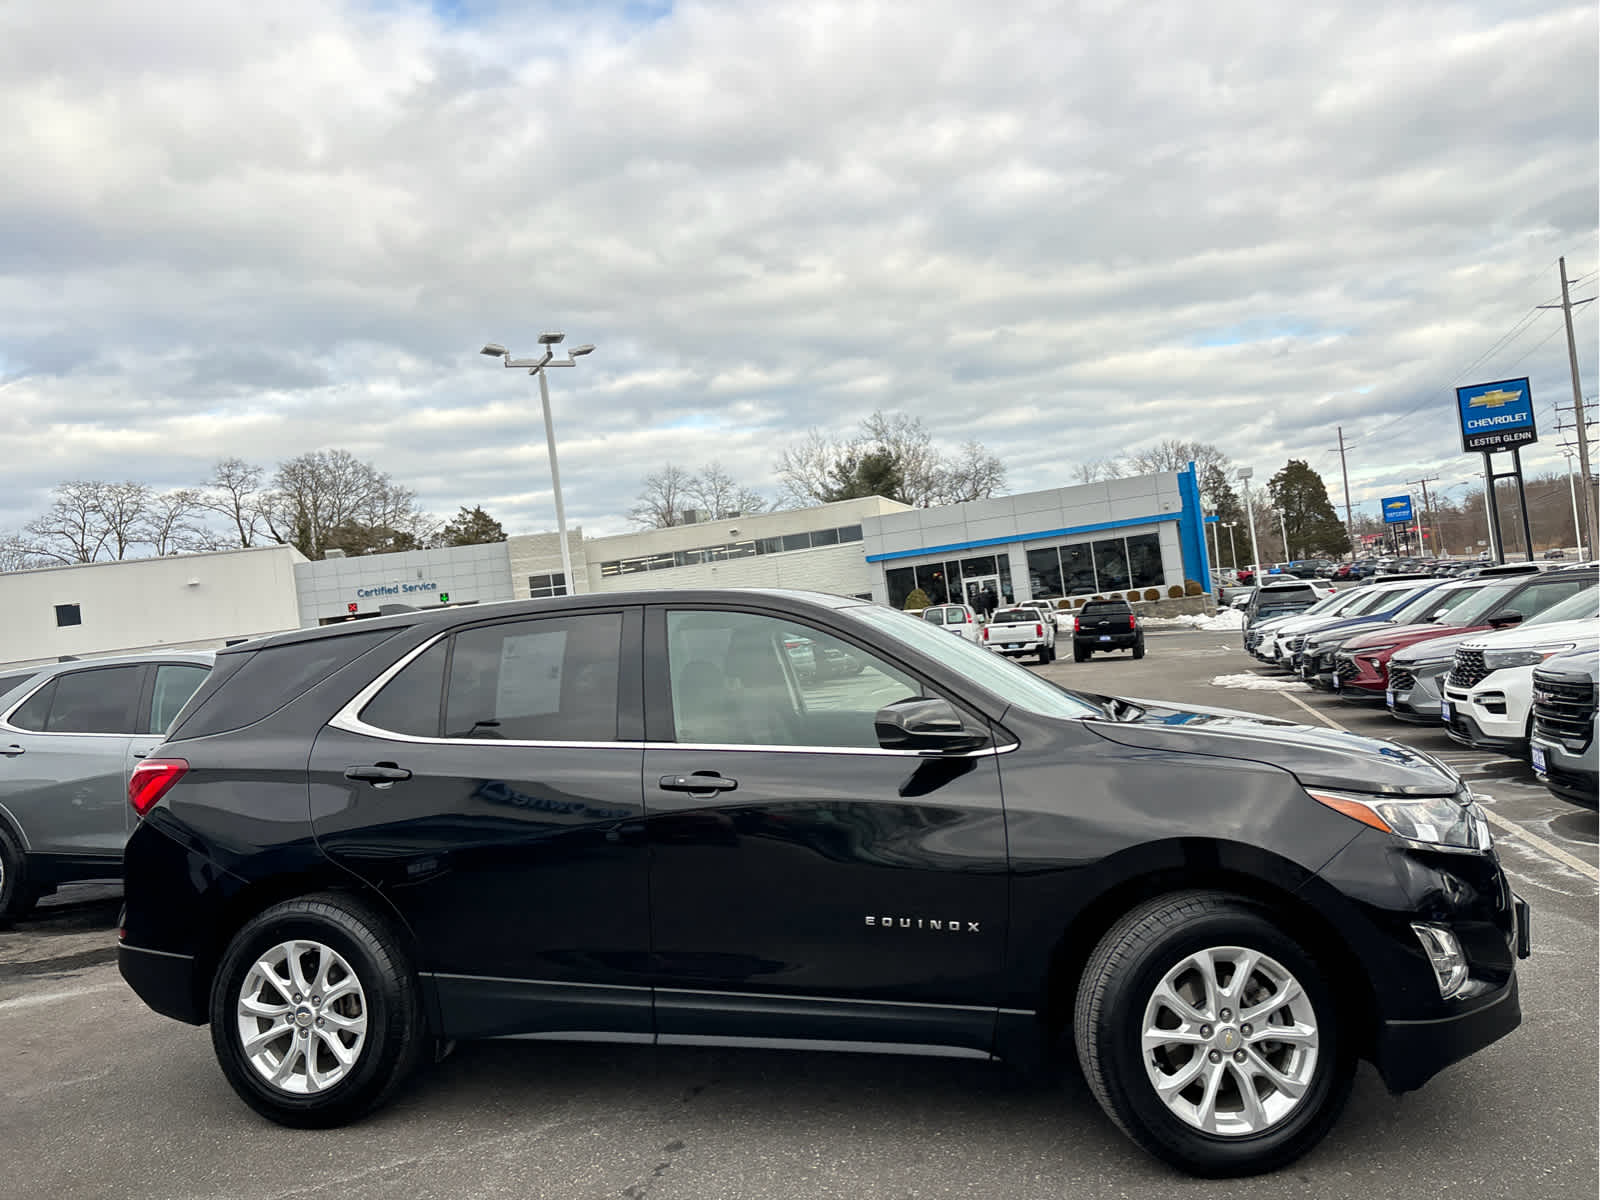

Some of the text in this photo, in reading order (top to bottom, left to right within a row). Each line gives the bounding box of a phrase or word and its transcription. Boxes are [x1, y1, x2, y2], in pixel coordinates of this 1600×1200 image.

[1467, 412, 1528, 428] CHEVROLET
[1469, 431, 1532, 447] LESTER GLENN
[357, 582, 437, 597] Certified Service
[865, 916, 980, 932] EQUINOX
